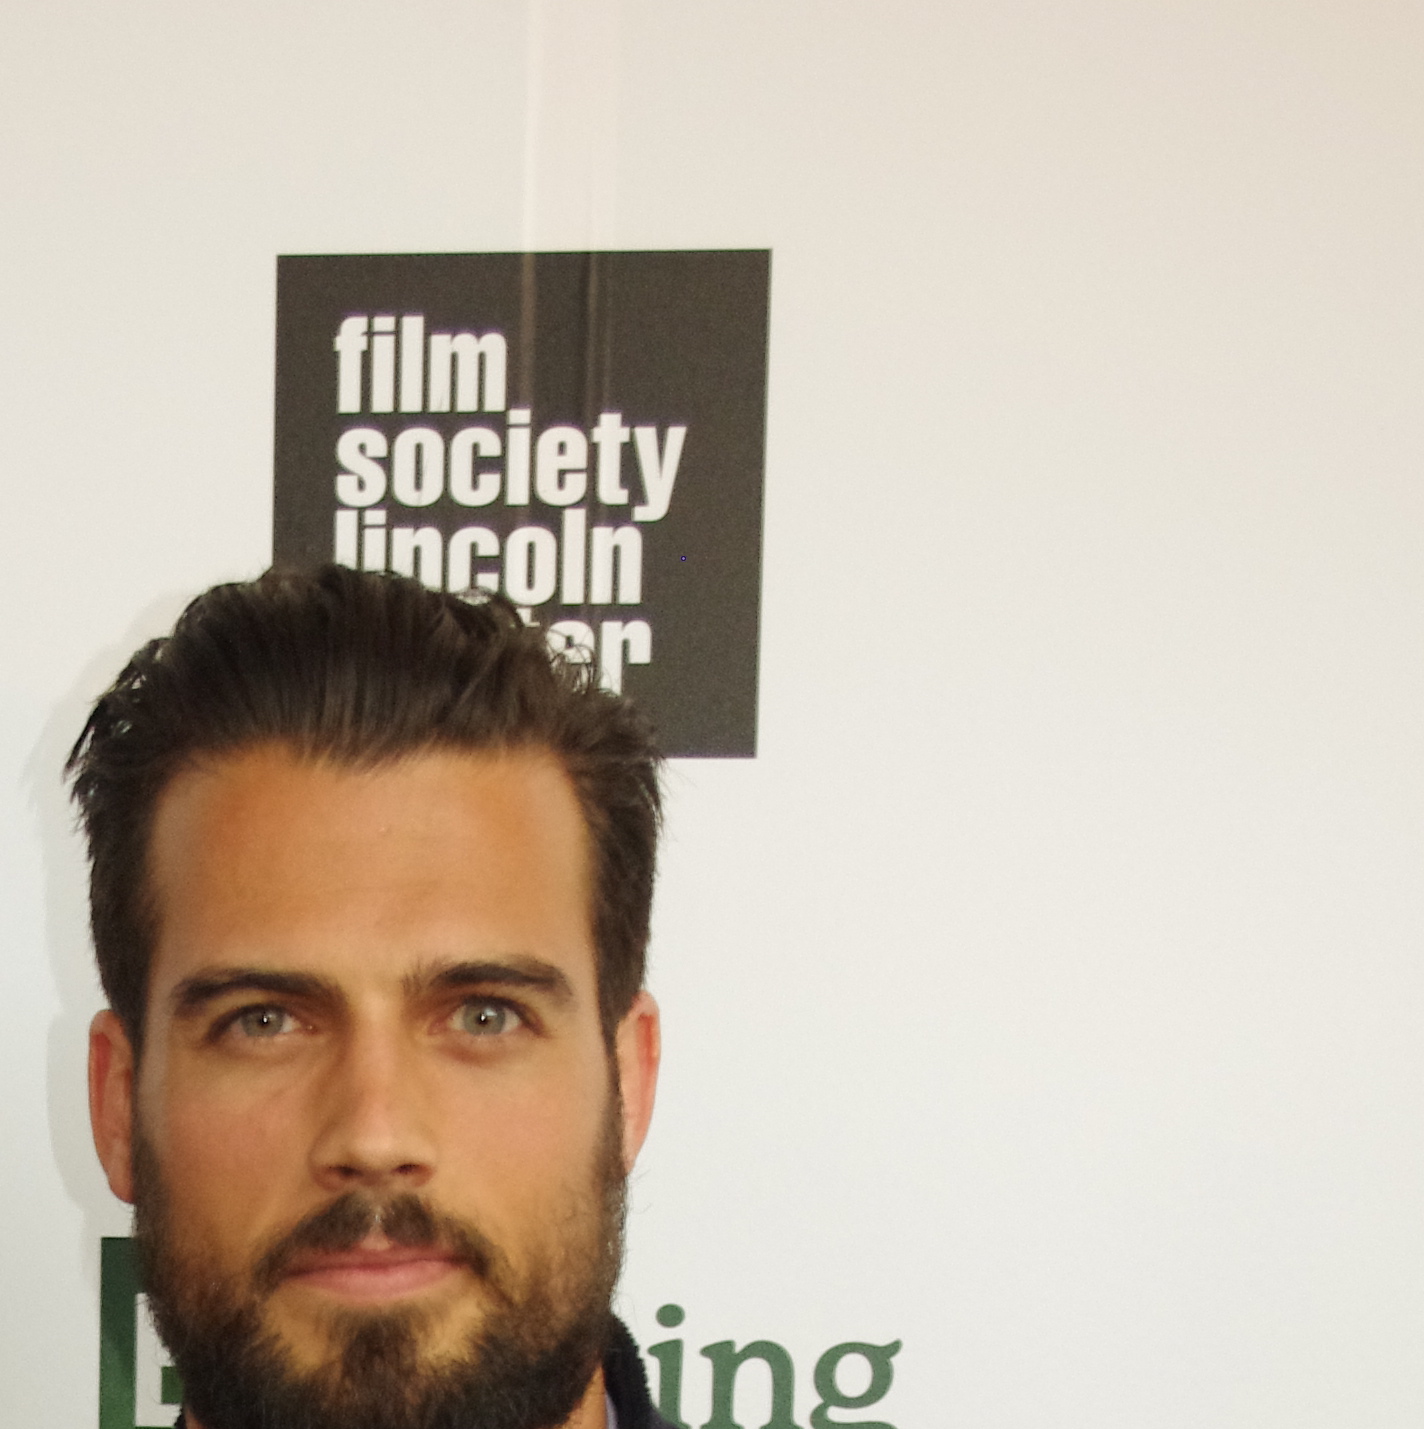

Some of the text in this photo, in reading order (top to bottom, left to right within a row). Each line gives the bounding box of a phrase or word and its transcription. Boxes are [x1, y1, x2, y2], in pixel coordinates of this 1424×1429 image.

[334, 315, 508, 413] film
[335, 409, 688, 522] society
[334, 508, 642, 605] lincoln
